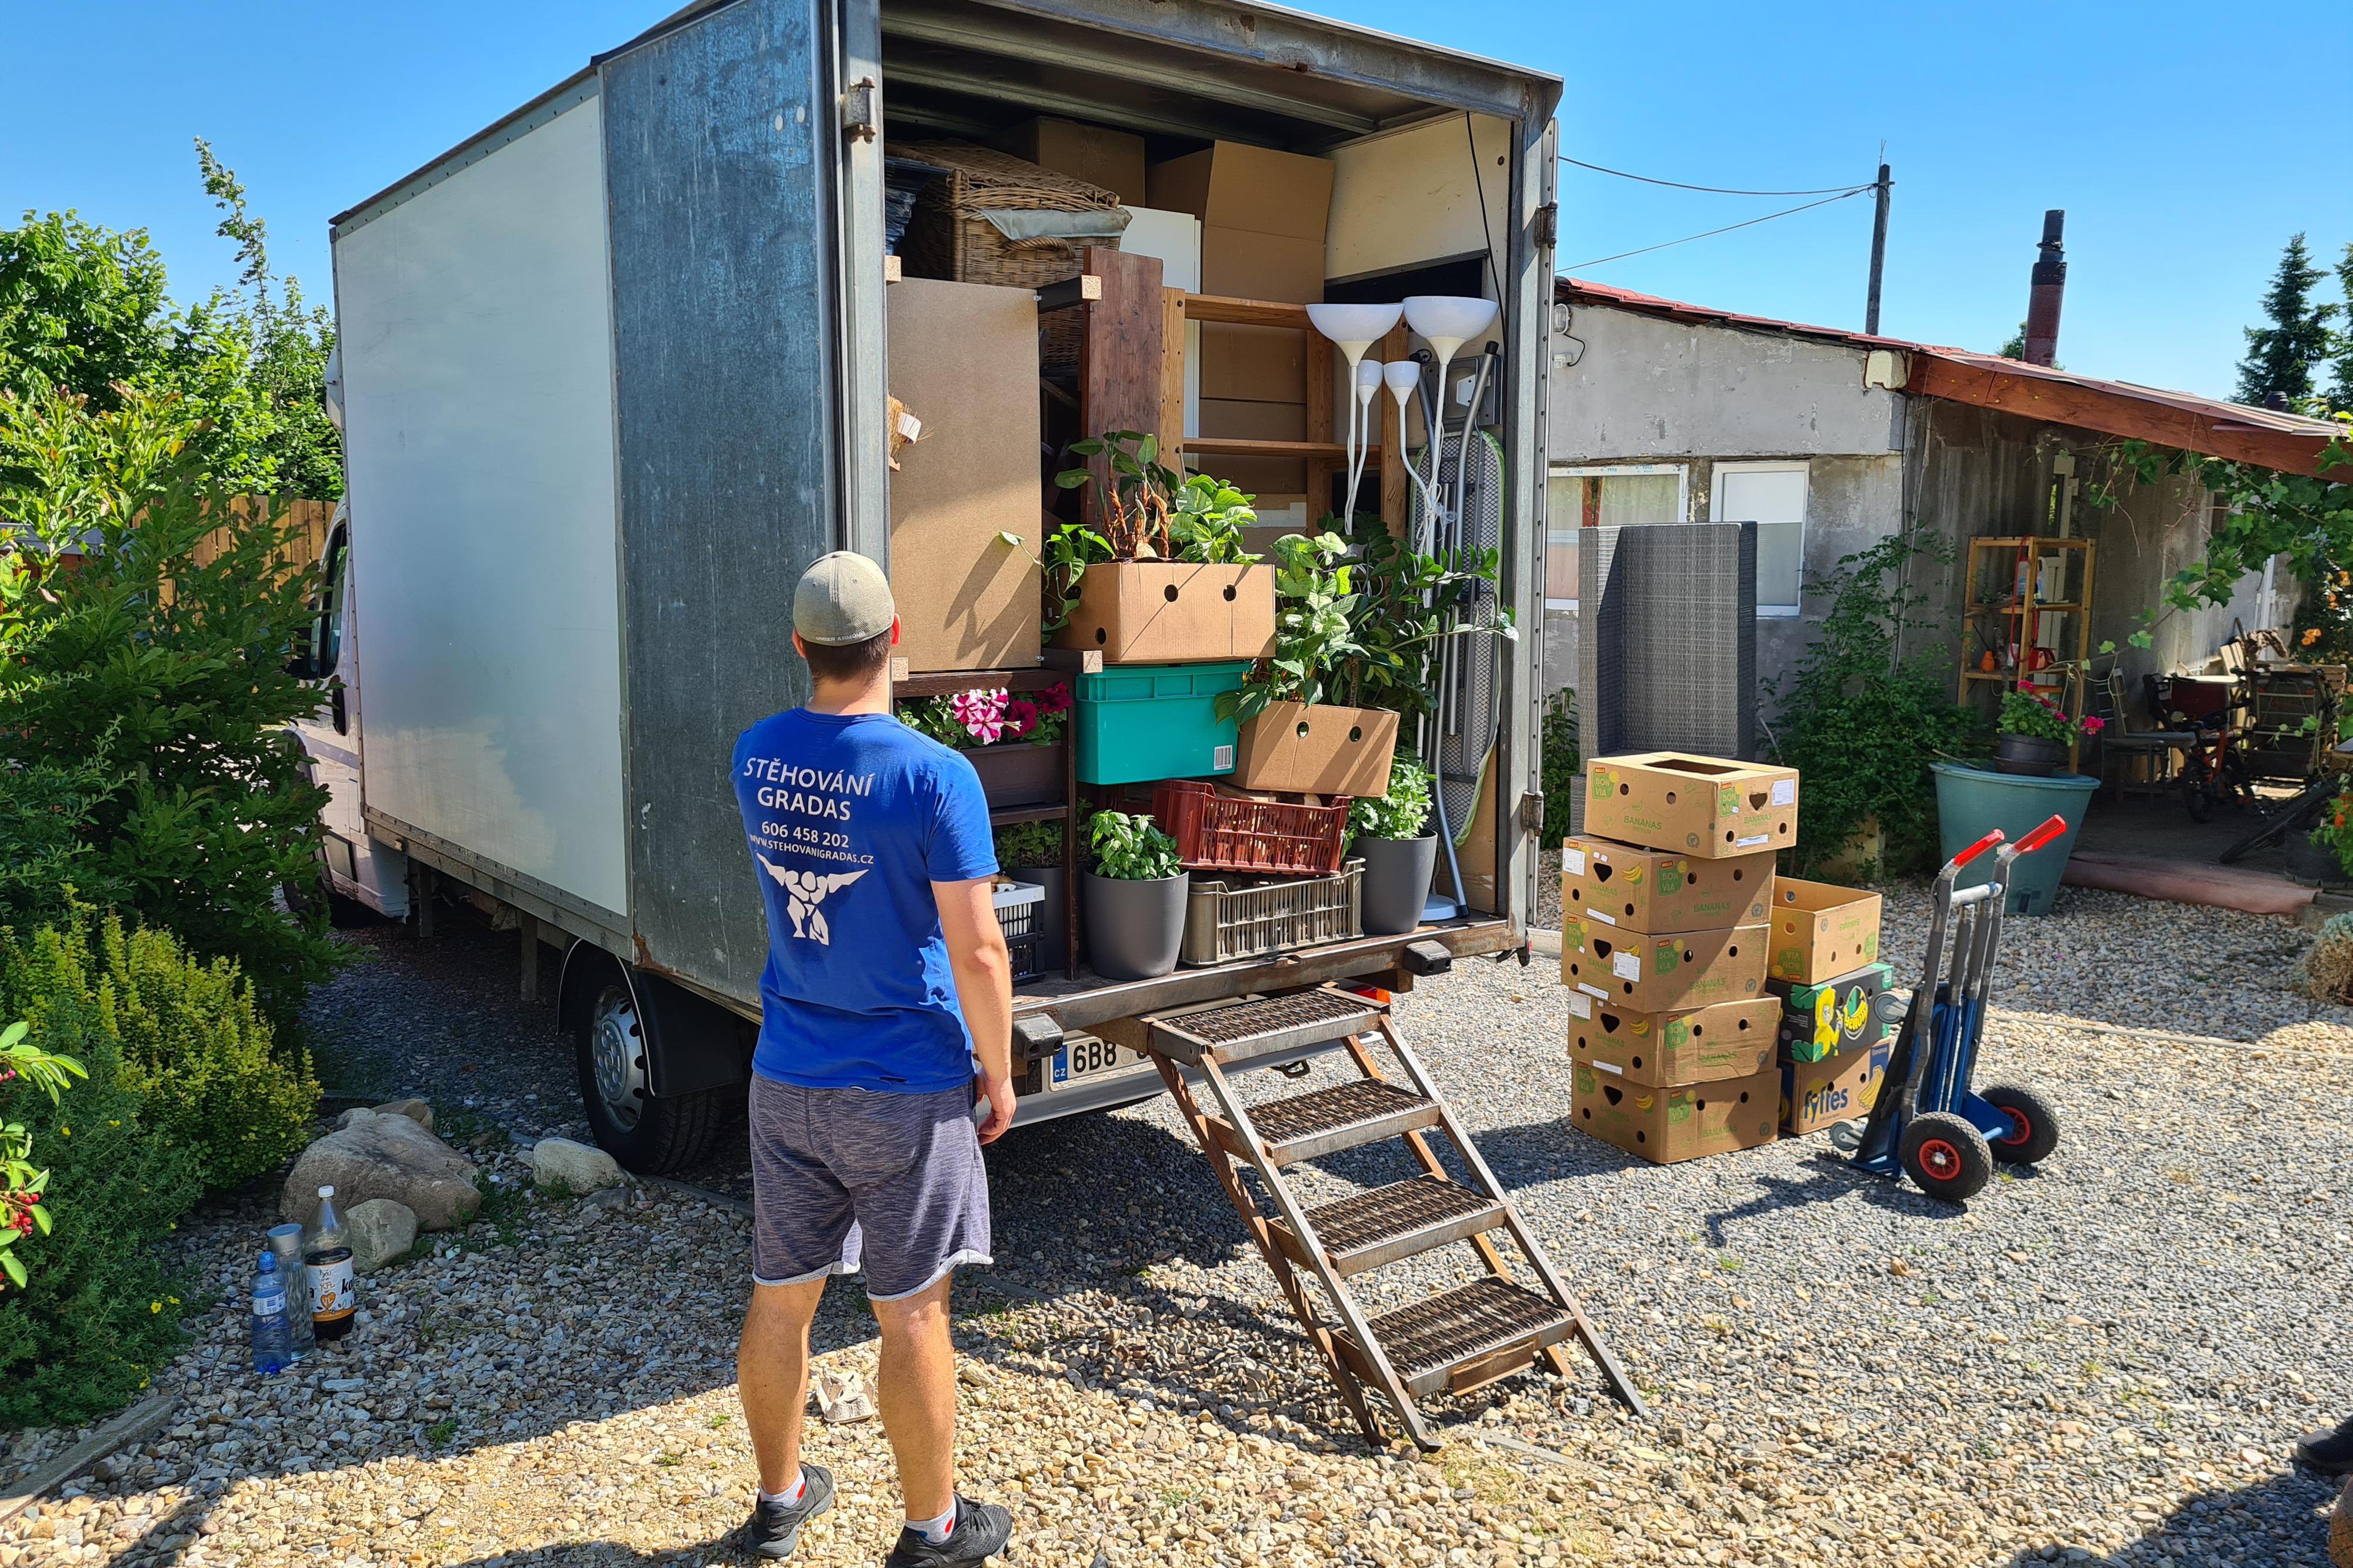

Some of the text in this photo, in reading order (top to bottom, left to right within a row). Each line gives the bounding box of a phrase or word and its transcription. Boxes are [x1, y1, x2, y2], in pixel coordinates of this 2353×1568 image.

[744, 757, 875, 796] STĚHOVÁNÍ
[758, 787, 851, 820] GRADAS
[1624, 816, 1662, 830] BANANAS
[1744, 813, 1772, 824] BANANAS
[762, 821, 849, 848] 606 458 202
[1589, 883, 1618, 896] BANANAS
[1694, 902, 1731, 912] BANANAS
[1588, 958, 1613, 972] BANANA
[1689, 979, 1726, 989] BANANAS
[1595, 1032, 1625, 1048] BANANAS
[1074, 1042, 1116, 1073] 6B8
[1055, 1068, 1066, 1077] CZ
[1703, 1125, 1737, 1137] BANANAS
